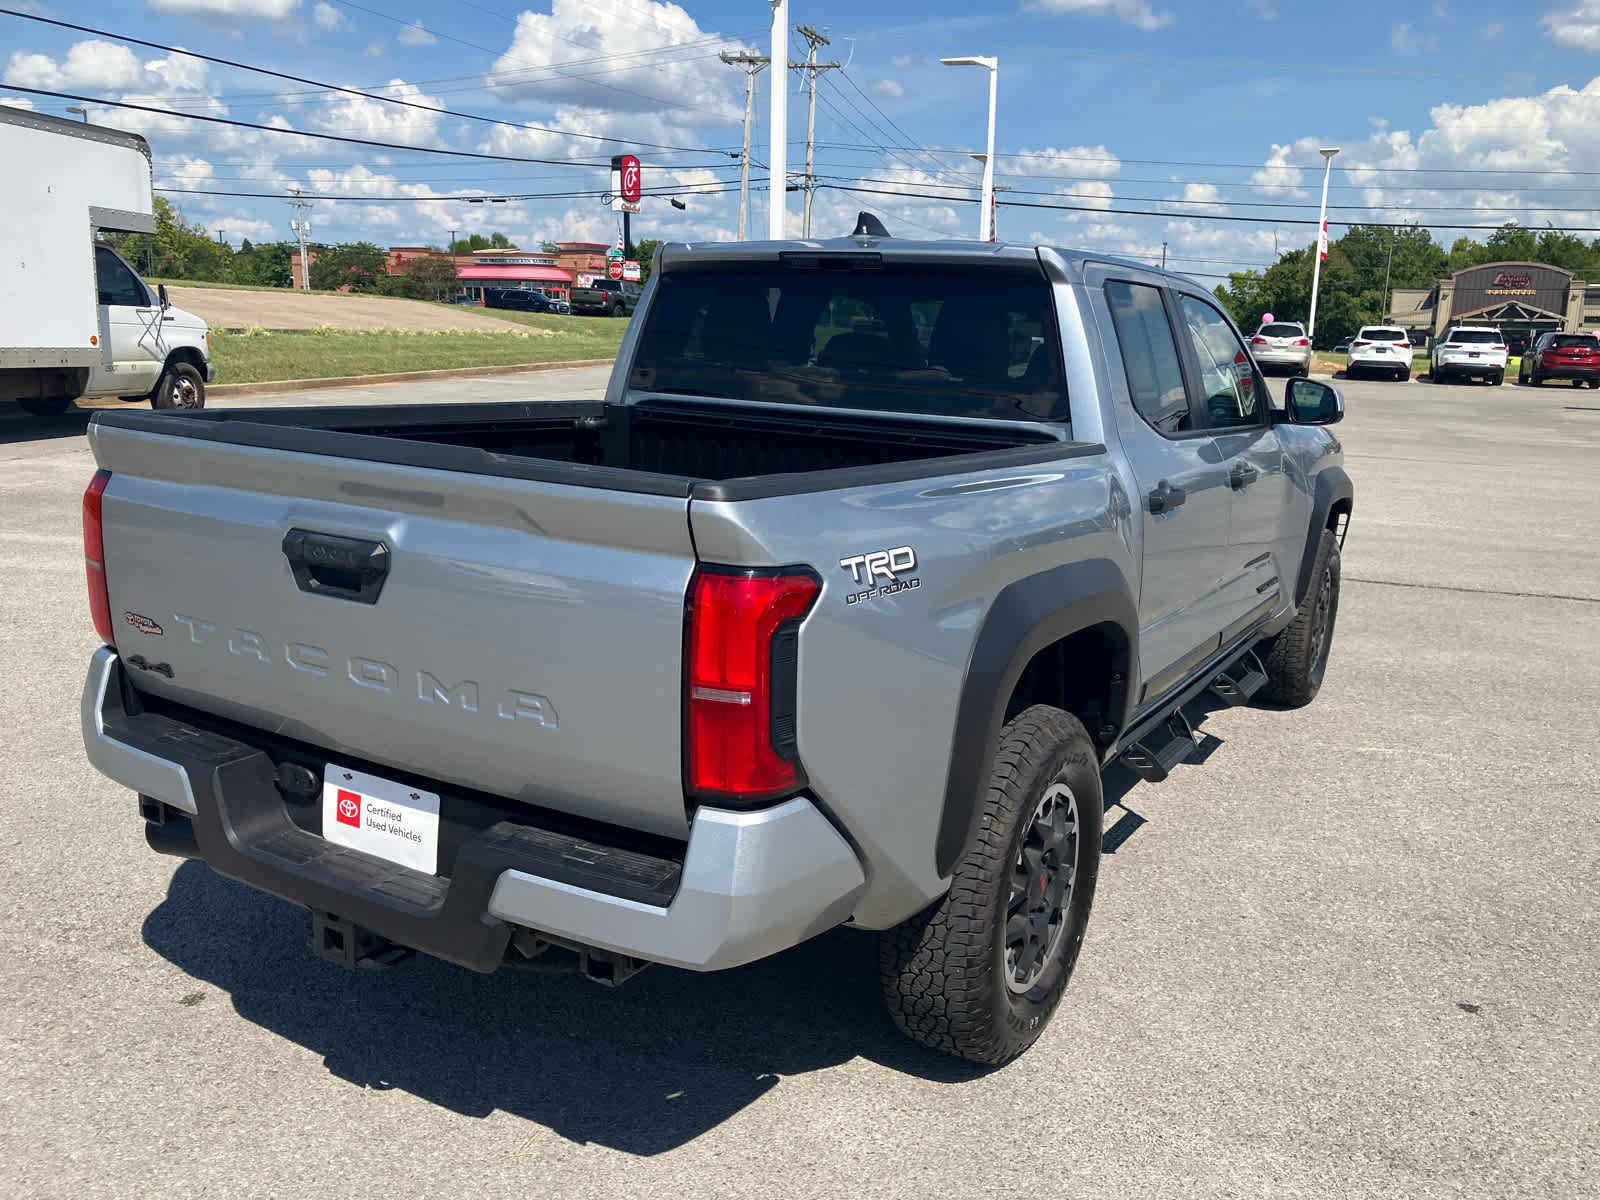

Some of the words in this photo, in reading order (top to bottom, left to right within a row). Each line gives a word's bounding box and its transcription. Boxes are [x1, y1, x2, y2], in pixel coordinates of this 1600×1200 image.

[840, 546, 916, 586] TRD
[846, 588, 877, 606] OFF
[880, 578, 921, 598] ROAD
[173, 614, 559, 729] TACOMA
[366, 803, 402, 822] Certified
[366, 817, 387, 832] Used
[388, 824, 422, 843] Vehicles
